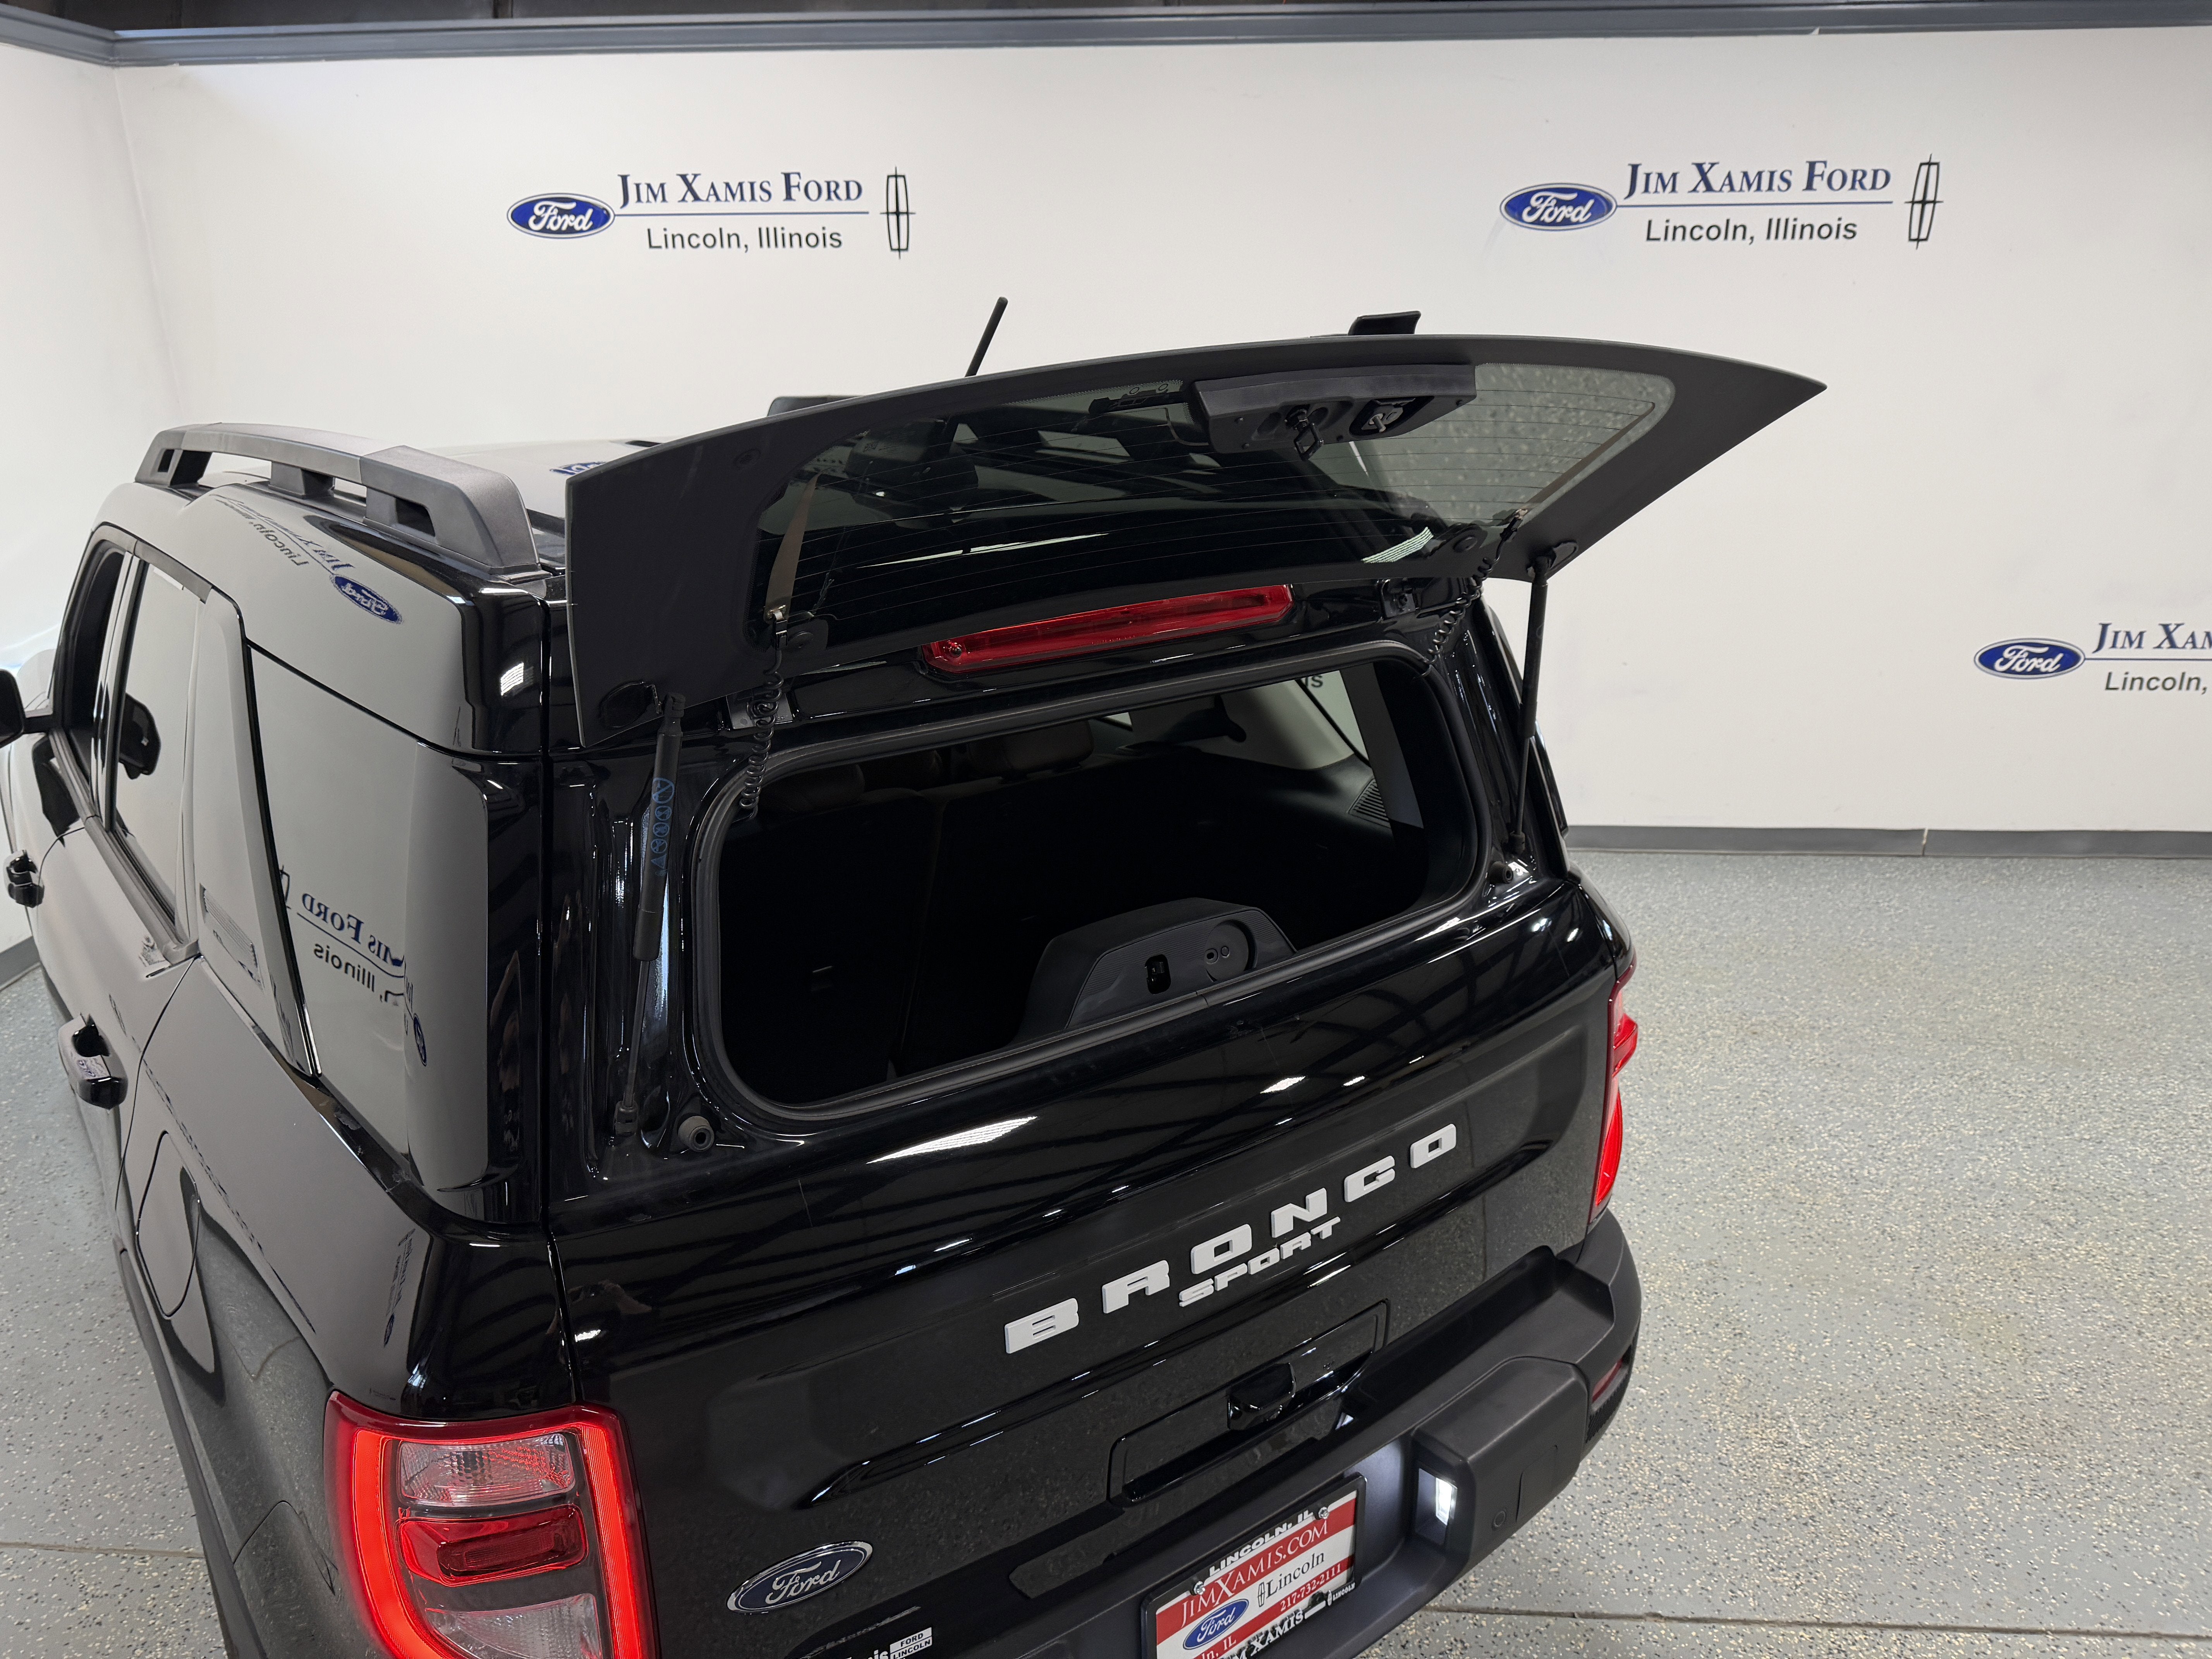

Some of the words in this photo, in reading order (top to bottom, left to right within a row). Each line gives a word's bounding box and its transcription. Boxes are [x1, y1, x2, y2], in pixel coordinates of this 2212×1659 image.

[617, 174, 668, 209] JIM
[676, 173, 772, 203] XAMIS
[781, 171, 863, 202] FORD
[1623, 163, 1680, 200] JIM
[1688, 162, 1792, 194] XAMIS
[1802, 160, 1891, 192] FORD
[528, 201, 593, 232] Ford
[1522, 190, 1592, 223] Ford
[647, 227, 749, 253] Lincoln,
[758, 226, 843, 249] Illinois
[1646, 218, 1755, 246] Lincoln,
[1766, 217, 1858, 241] Illinois
[2092, 622, 2147, 653] JIM
[1994, 645, 2064, 673] Ford
[2104, 672, 2207, 694] Lincoln,
[1005, 1124, 1456, 1354] BRONCO
[1179, 1216, 1341, 1307] SPORT
[1209, 1522, 1292, 1577] LINCOLN,
[1297, 1510, 1313, 1523] IL
[765, 1559, 841, 1604] Ford
[1181, 1520, 1328, 1627] JIMXAMIS.COM
[1266, 1553, 1324, 1599] Lincoln
[1280, 1563, 1341, 1612] 217-732-2111
[1333, 1582, 1355, 1601] LINCOLN
[900, 1633, 924, 1647] FORD
[1197, 1607, 1236, 1642] Ford
[1250, 1607, 1304, 1657] XAMIS
[893, 1639, 931, 1659] LINCOLN
[1223, 1635, 1236, 1650] IL
